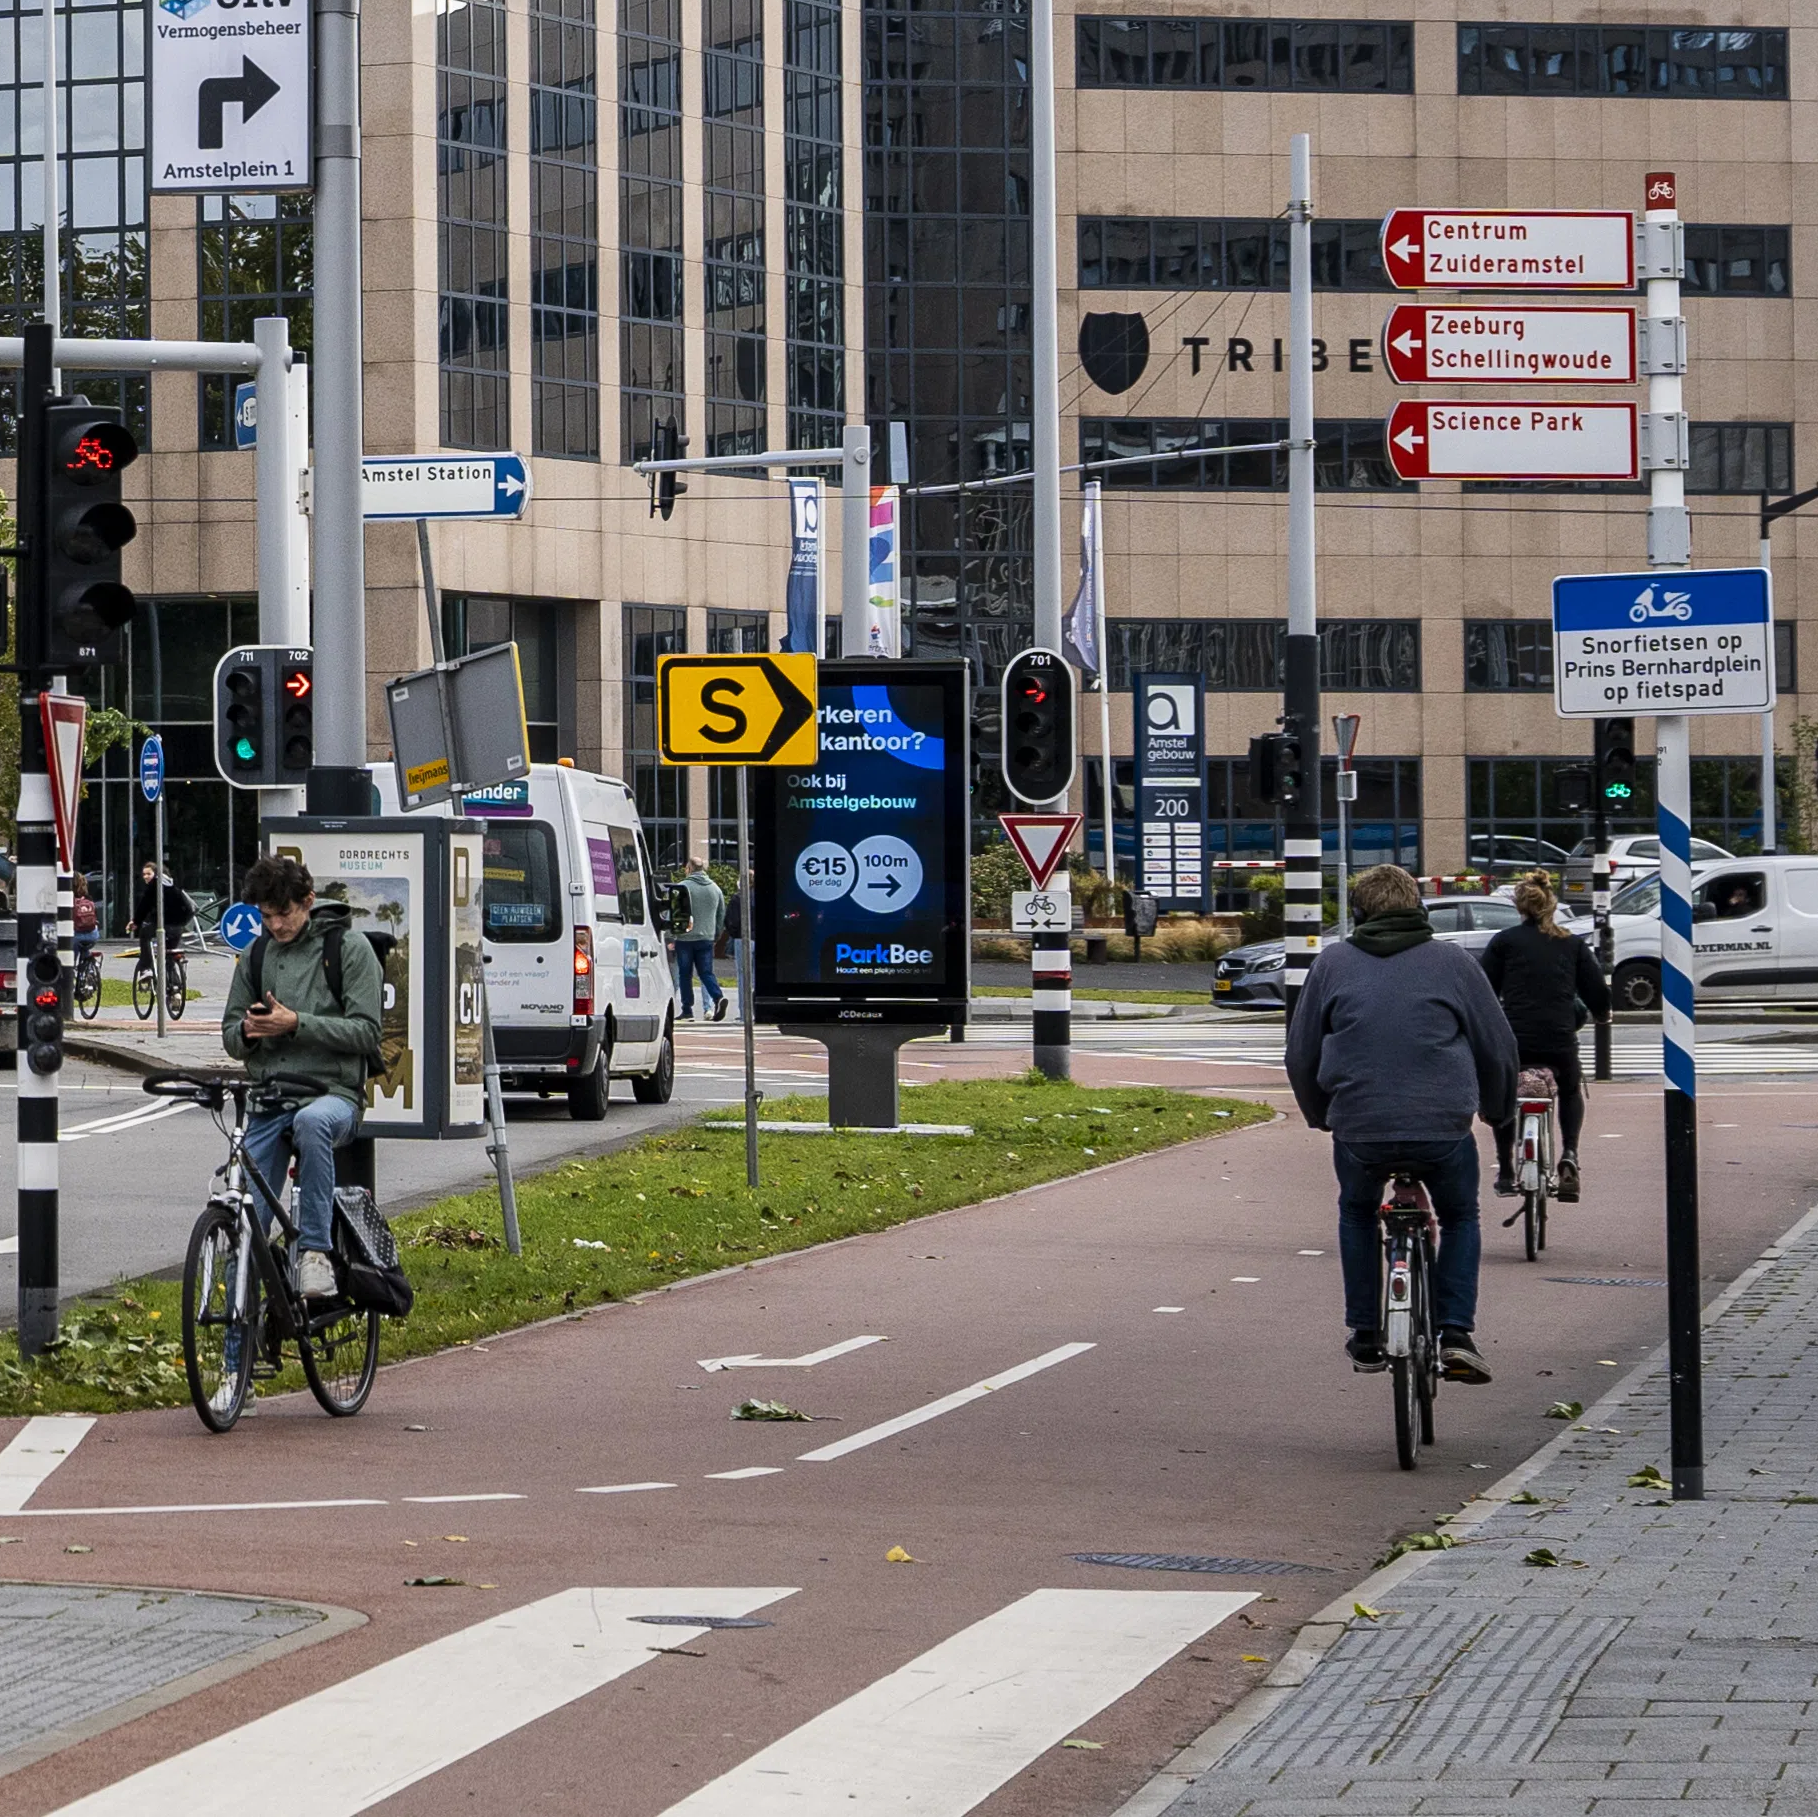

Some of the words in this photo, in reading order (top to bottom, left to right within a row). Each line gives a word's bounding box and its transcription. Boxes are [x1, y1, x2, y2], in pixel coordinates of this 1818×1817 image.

[157, 20, 302, 39] Vermogensbeheer
[163, 161, 277, 180] Amstelplein
[283, 161, 295, 176] 1
[1427, 221, 1528, 241] Centrum
[1429, 254, 1585, 274] Zuideramstel
[1430, 315, 1525, 341] Zeeburg
[1430, 349, 1612, 374] Schellingwoude
[1432, 411, 1522, 431] Science
[1531, 412, 1584, 431] Park
[427, 466, 492, 481] Station
[1582, 635, 1708, 655] Snorfietsen
[1717, 634, 1743, 653] op
[239, 651, 254, 662] 711
[288, 650, 309, 661] 702
[1029, 654, 1051, 666] 701
[1565, 661, 1616, 678] Prins
[1622, 655, 1762, 677] Bernhardplein
[1603, 685, 1629, 704] op
[1636, 679, 1724, 701] fietspad
[698, 677, 748, 744] S
[820, 732, 926, 751] kantoor?
[1148, 737, 1188, 748] Amstel
[1147, 748, 1196, 762] gebouw
[408, 764, 448, 786] heijmans
[786, 774, 822, 788] Ook
[825, 774, 847, 791] bij
[787, 794, 917, 812] Amstelgebouw
[1154, 799, 1189, 817] 200
[339, 861, 384, 871] MUSEUM
[801, 857, 847, 876] €15
[864, 854, 909, 868] 100m
[825, 877, 842, 887] dag
[835, 943, 934, 964] ParkBee
[838, 1010, 884, 1019] JCDecaux
